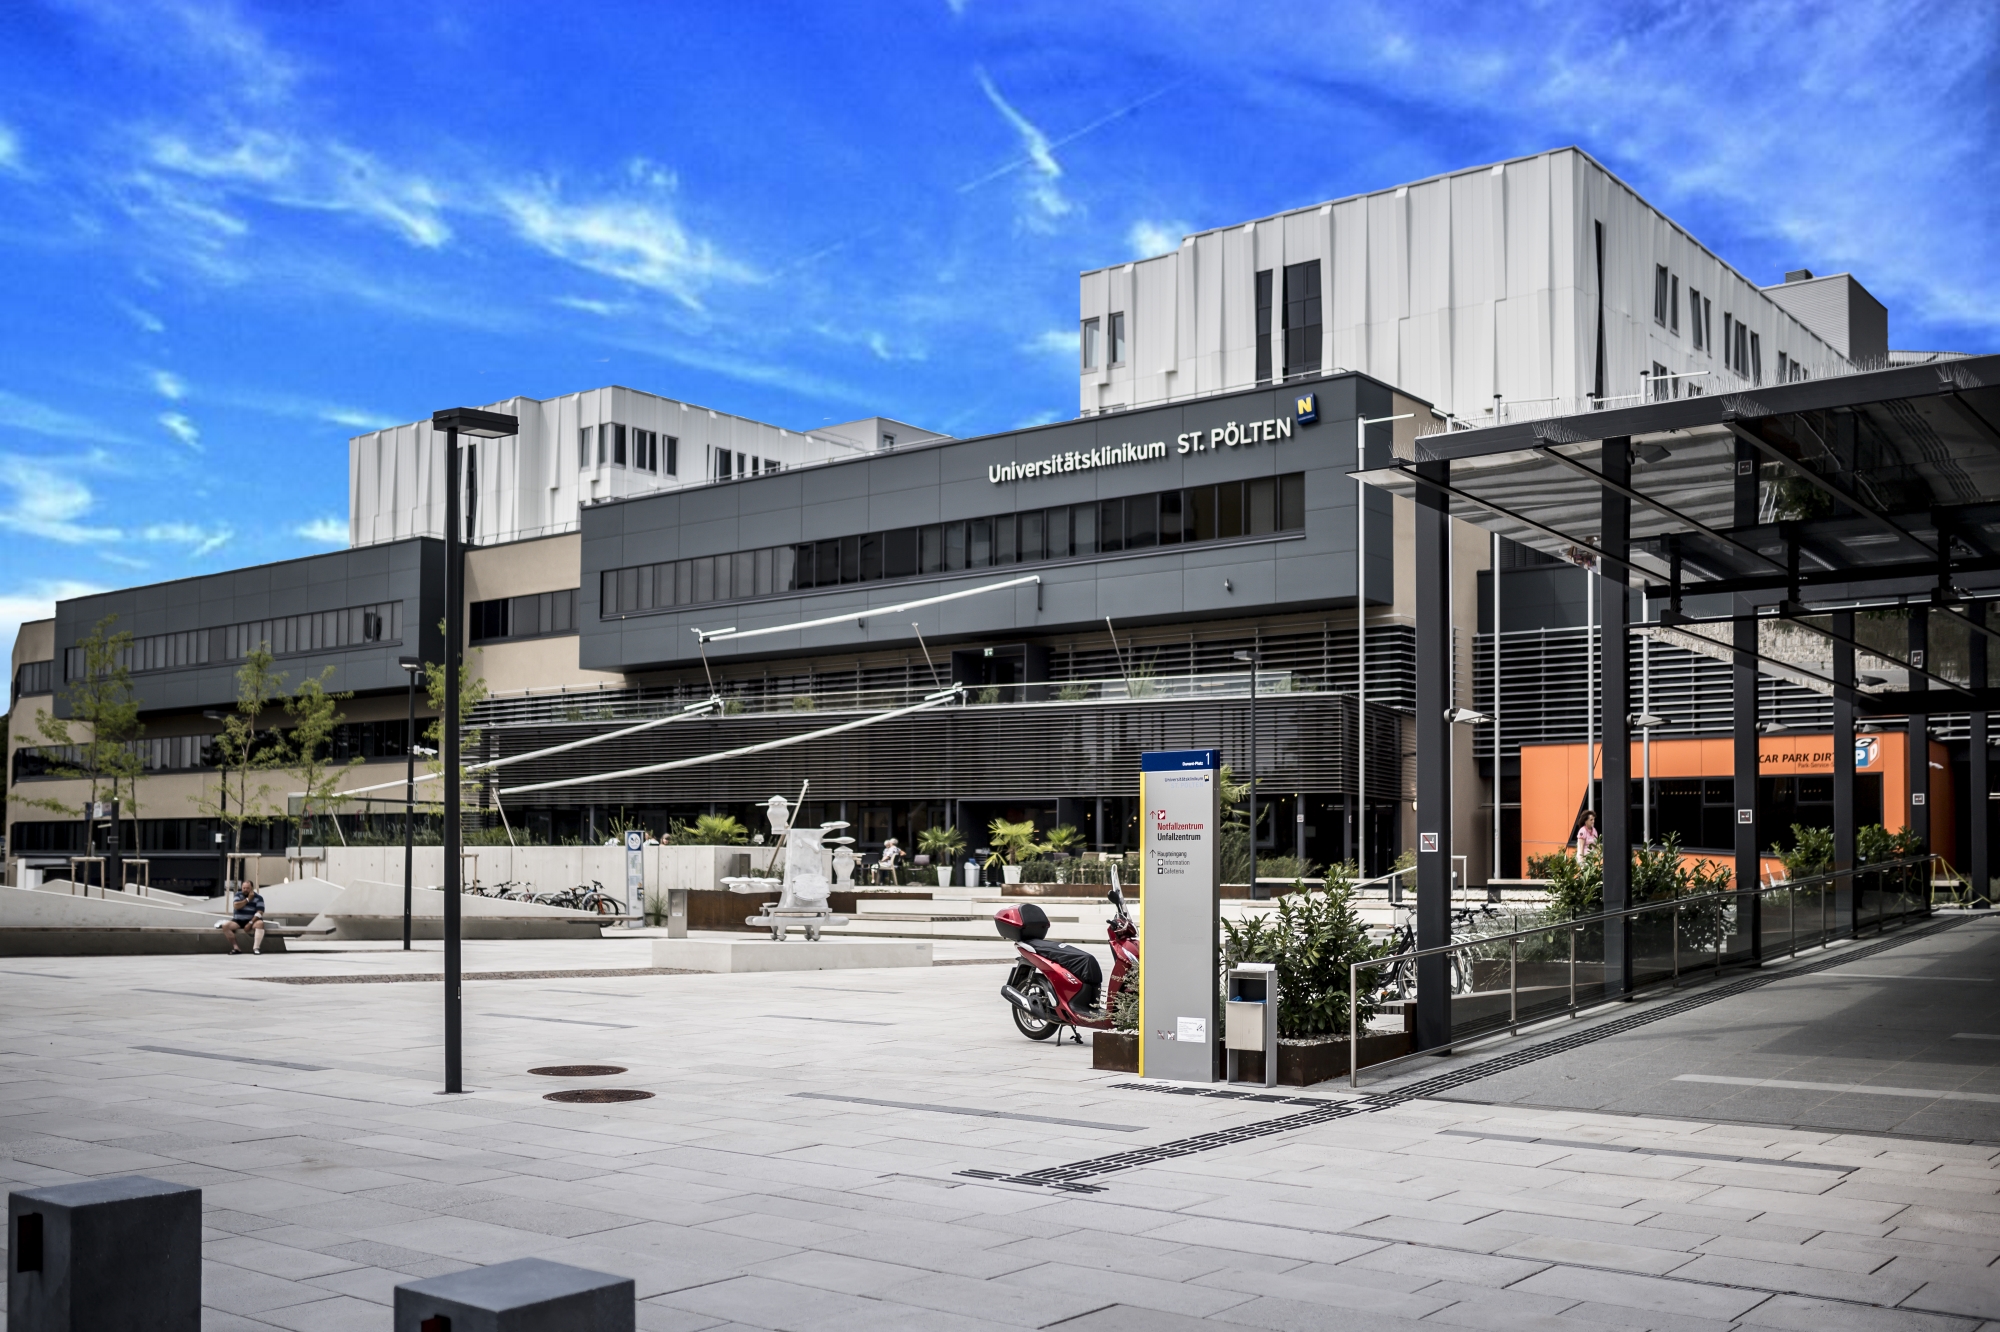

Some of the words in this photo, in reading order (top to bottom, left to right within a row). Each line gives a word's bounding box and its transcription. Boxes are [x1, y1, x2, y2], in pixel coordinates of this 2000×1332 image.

[1298, 396, 1312, 415] N
[988, 440, 1166, 483] Universitätsklinikum
[1177, 431, 1204, 454] ST.
[1211, 416, 1291, 448] PÖLTEN
[1206, 752, 1210, 765] 1
[1759, 754, 1779, 764] CAR
[1782, 753, 1810, 763] PARK
[1813, 752, 1835, 762] DIR
[1157, 822, 1204, 831] Notfallzentrum
[1157, 833, 1201, 841] Unfallzentrum
[1157, 851, 1187, 859] Haupteingang
